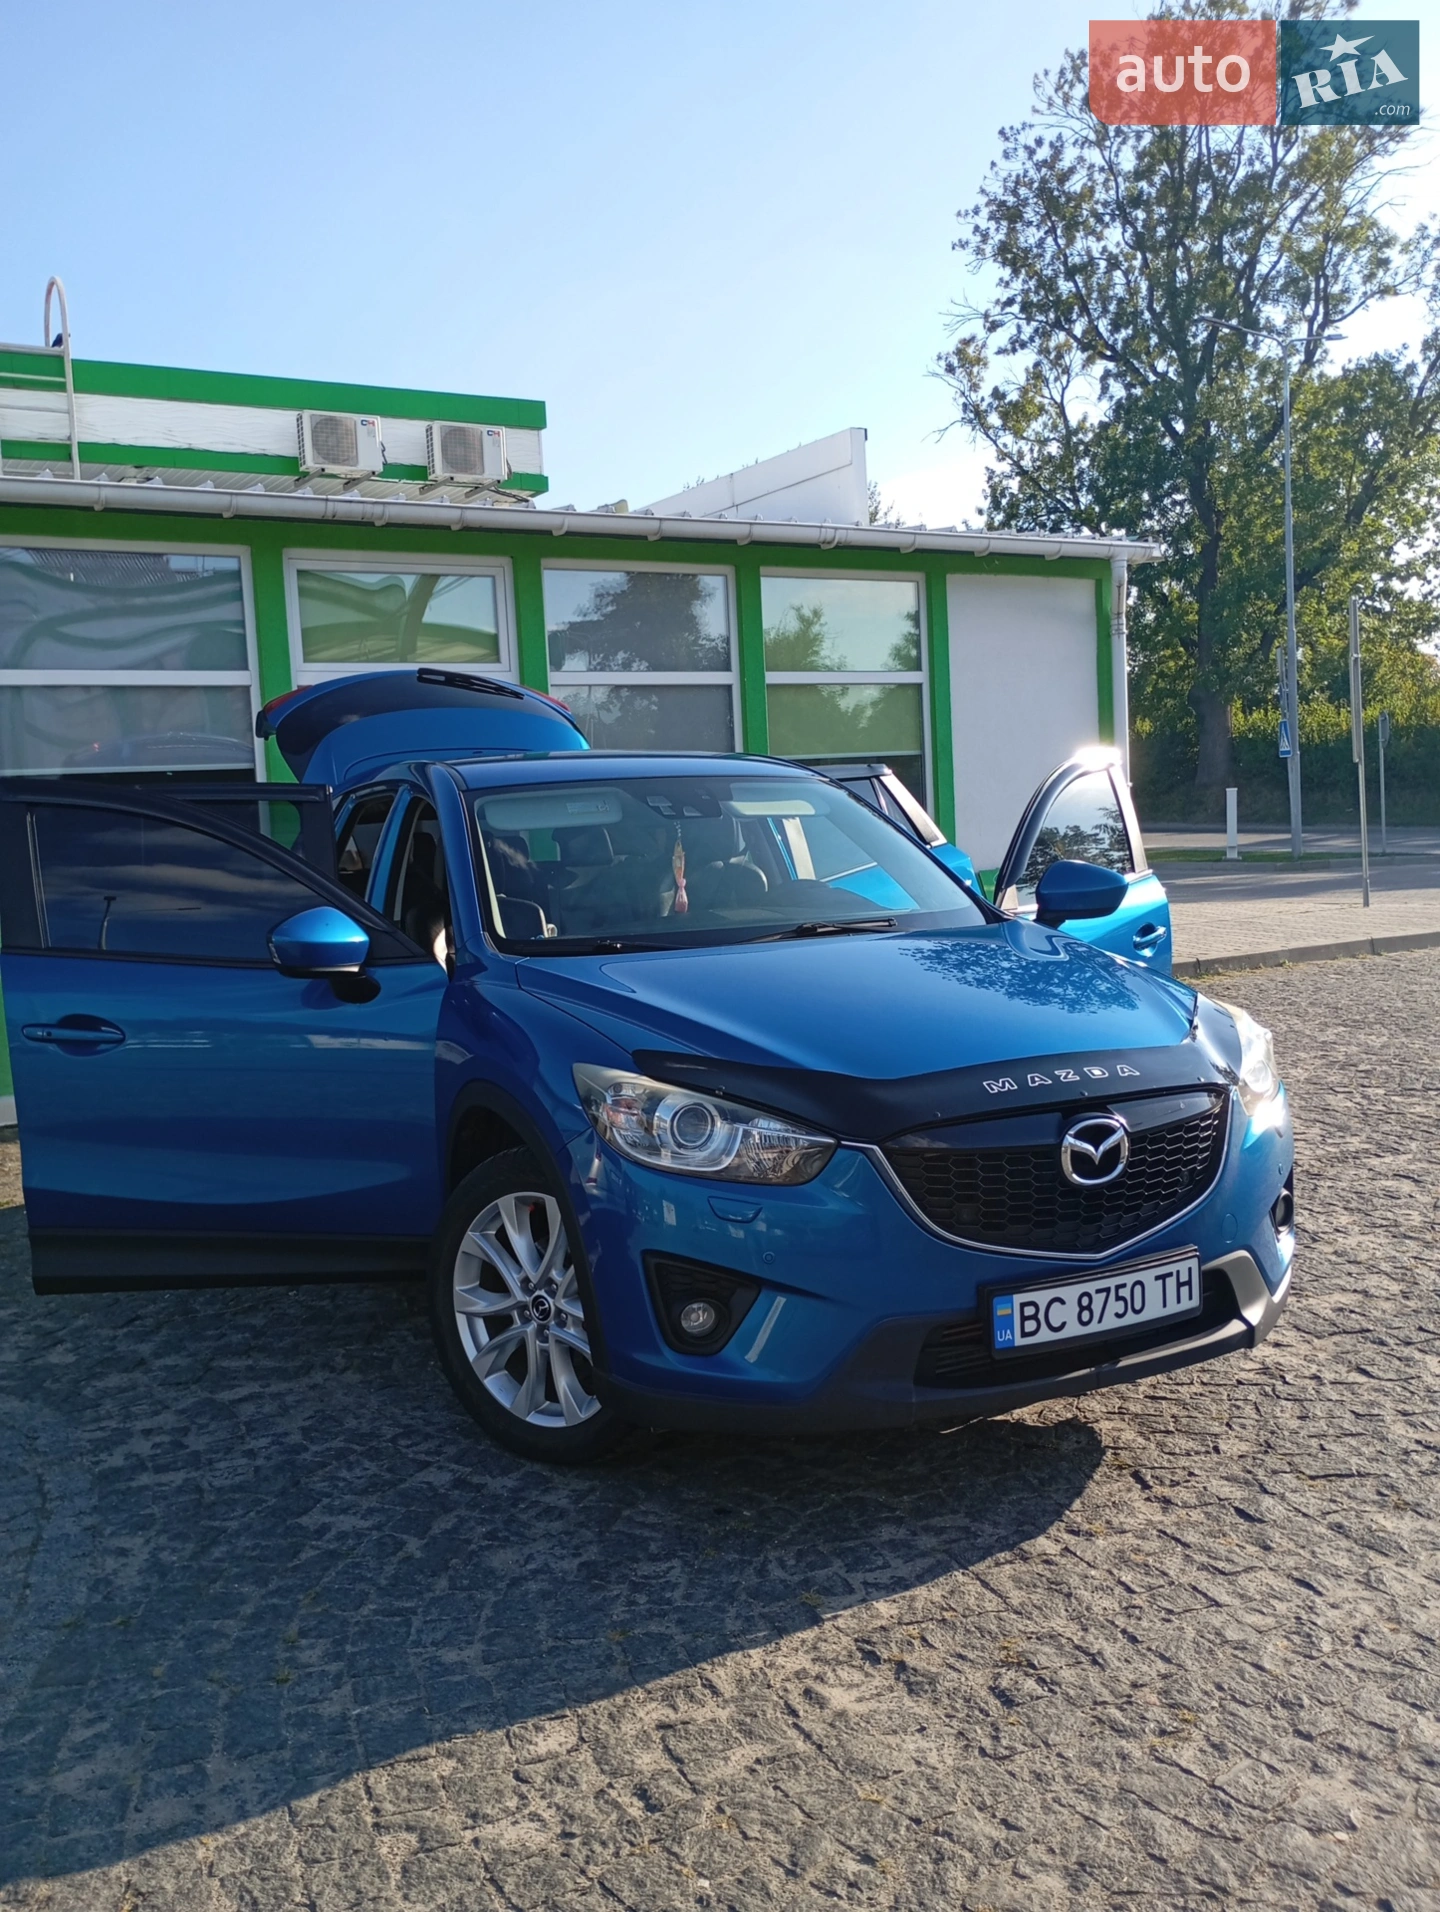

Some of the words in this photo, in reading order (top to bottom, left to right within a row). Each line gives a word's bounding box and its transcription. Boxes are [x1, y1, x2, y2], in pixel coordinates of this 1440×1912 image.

[360, 418, 375, 427] CH
[486, 429, 500, 437] CH
[983, 1064, 1140, 1094] MAZDA
[1019, 1296, 1067, 1339] BC
[1077, 1279, 1146, 1327] 8750
[1154, 1266, 1194, 1309] TH
[997, 1329, 1013, 1342] UA
